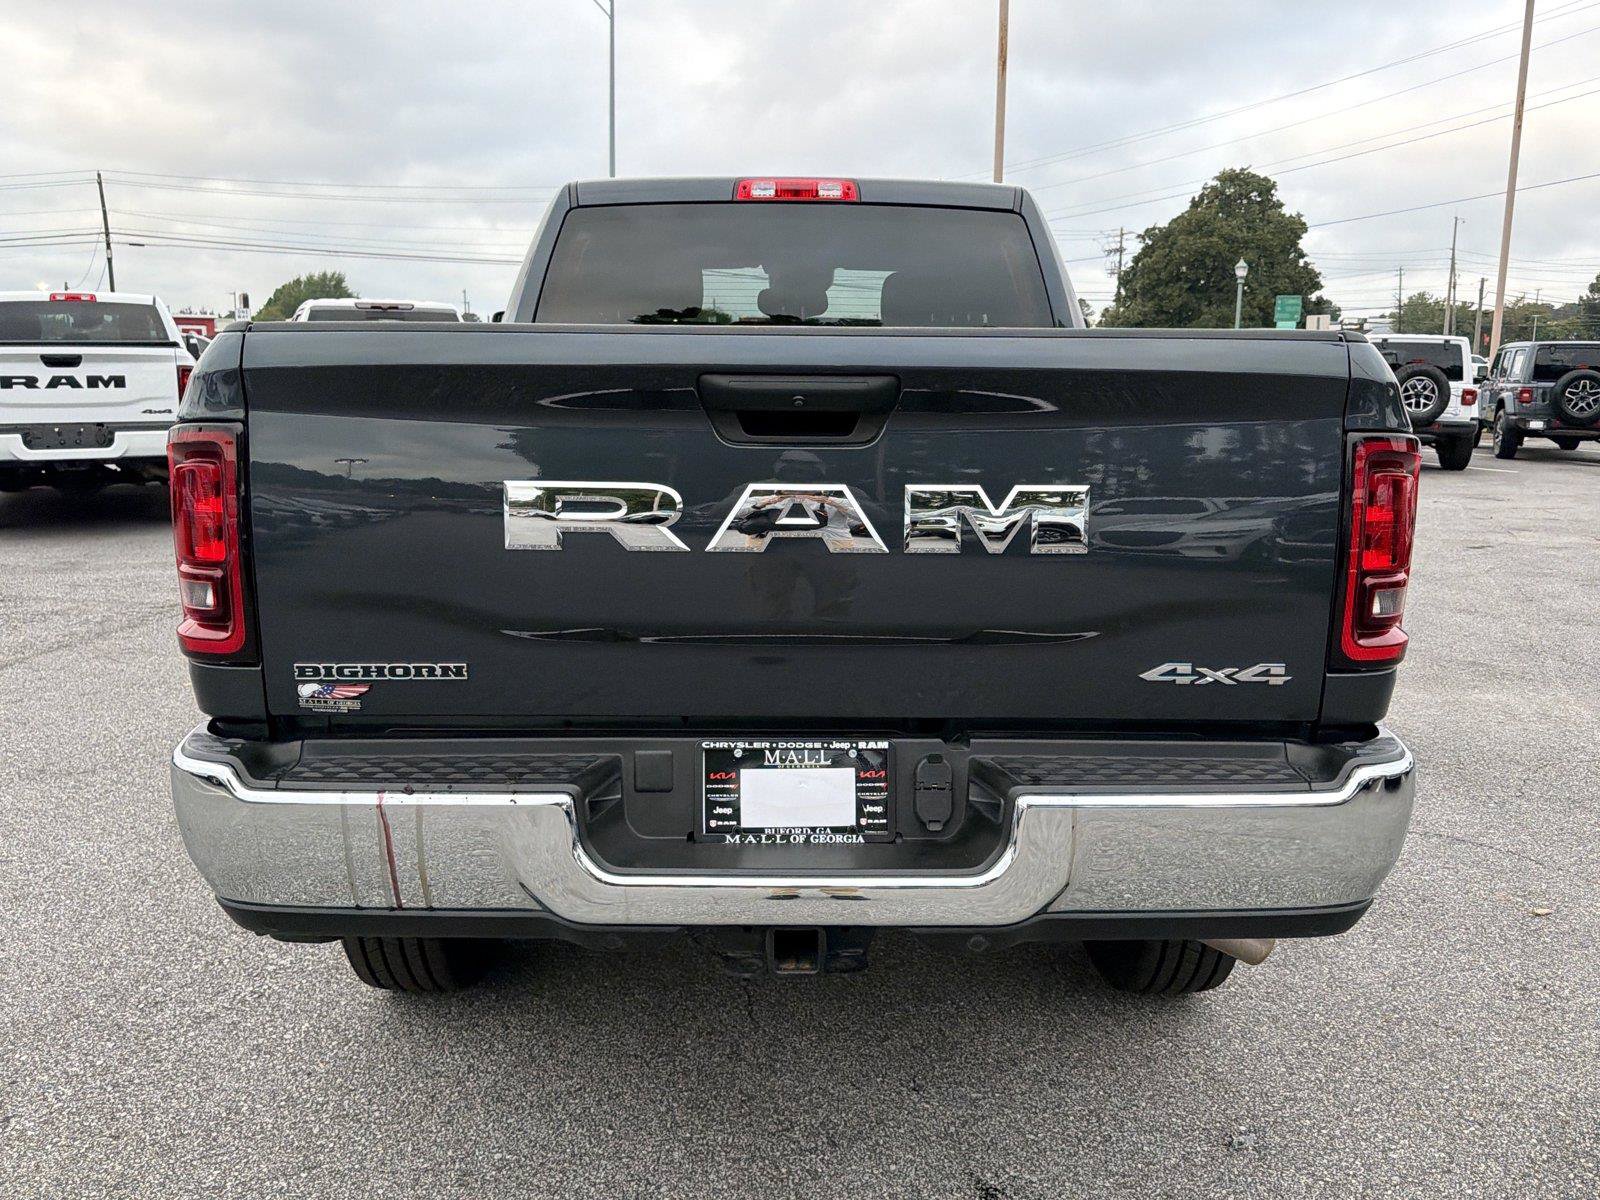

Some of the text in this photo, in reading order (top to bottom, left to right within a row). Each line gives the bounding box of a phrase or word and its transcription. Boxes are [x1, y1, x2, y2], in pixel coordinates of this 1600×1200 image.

[0, 374, 126, 389] RAM
[502, 480, 1092, 555] RAM
[293, 663, 468, 680] BIGHORN
[1137, 662, 1293, 685] 4x4
[702, 741, 771, 749] CHRYSLER
[829, 741, 850, 750] Jeep
[858, 741, 889, 749] RAM
[713, 806, 733, 814] Jeep
[864, 805, 883, 813] Jeep
[790, 835, 804, 844] OF
[810, 835, 865, 844] GEORGIA
